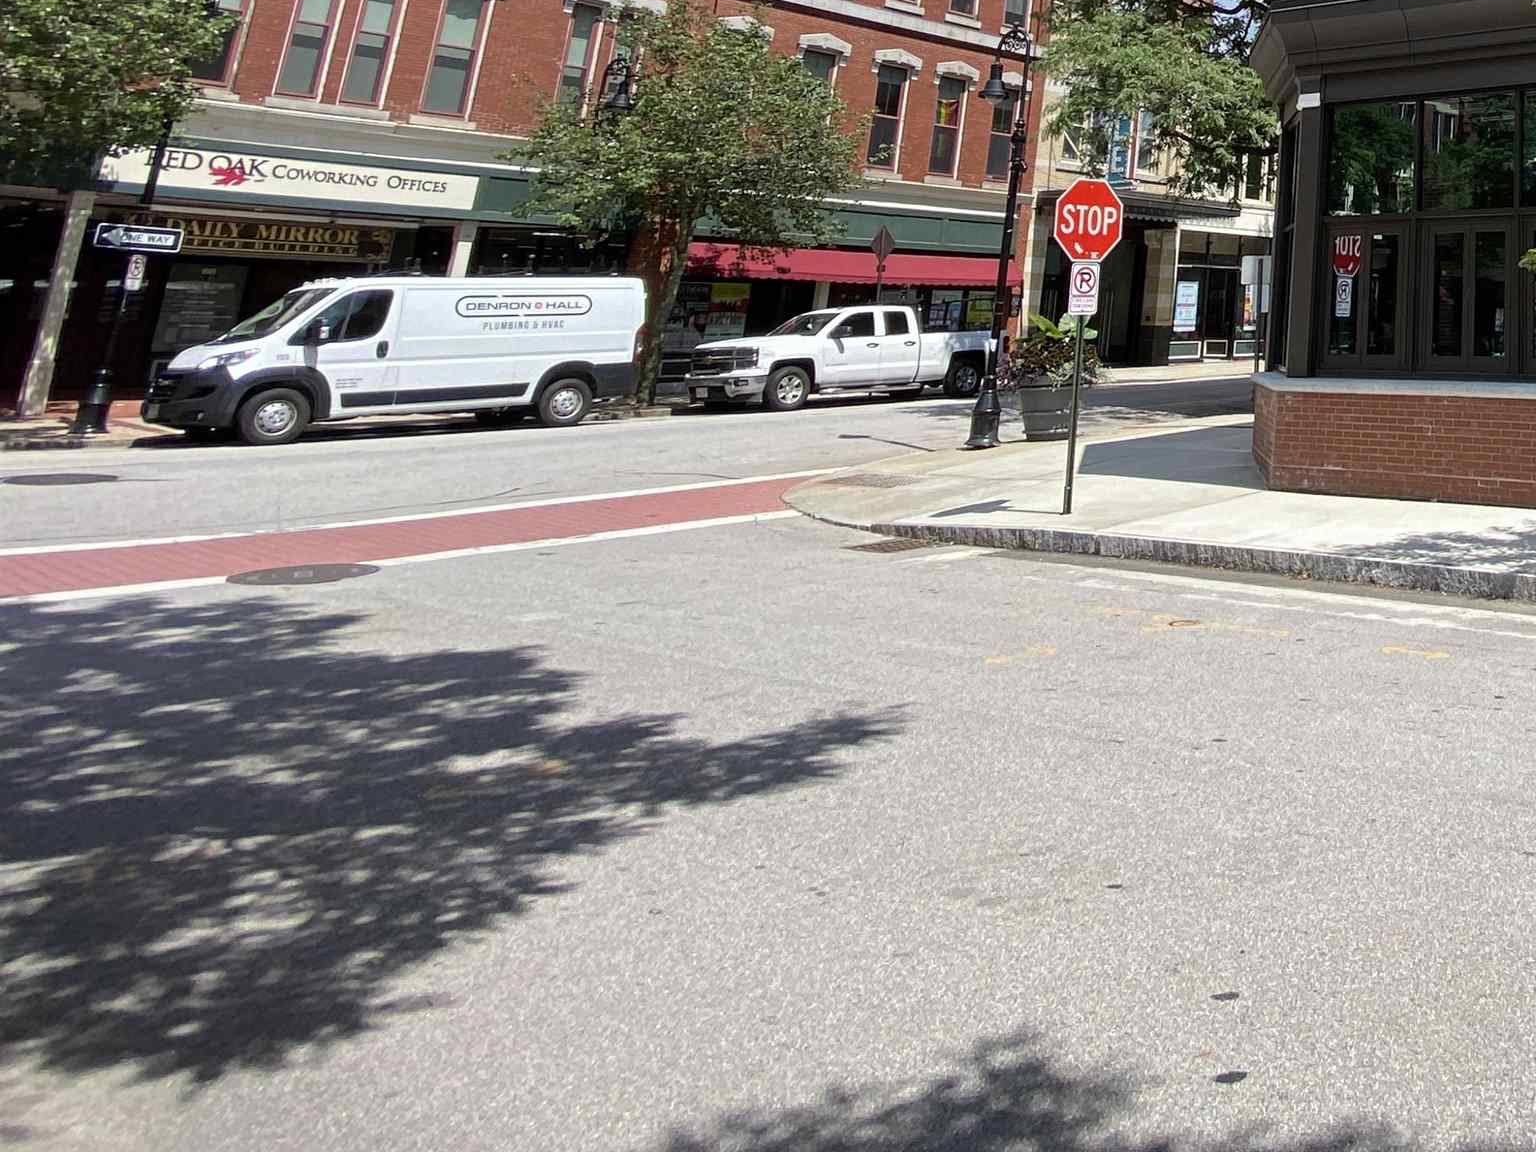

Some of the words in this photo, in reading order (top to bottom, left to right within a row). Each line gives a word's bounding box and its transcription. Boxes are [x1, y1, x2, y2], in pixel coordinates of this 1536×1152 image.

[209, 155, 268, 179] OAK
[1060, 203, 1117, 236] STOP
[121, 232, 144, 242] ONE
[147, 234, 171, 244] WAY
[167, 218, 245, 239] DAILY
[255, 224, 359, 245] MIRROR
[545, 301, 583, 309] HALL
[482, 321, 530, 331] PLUMBING
[542, 319, 565, 329] HVAC
